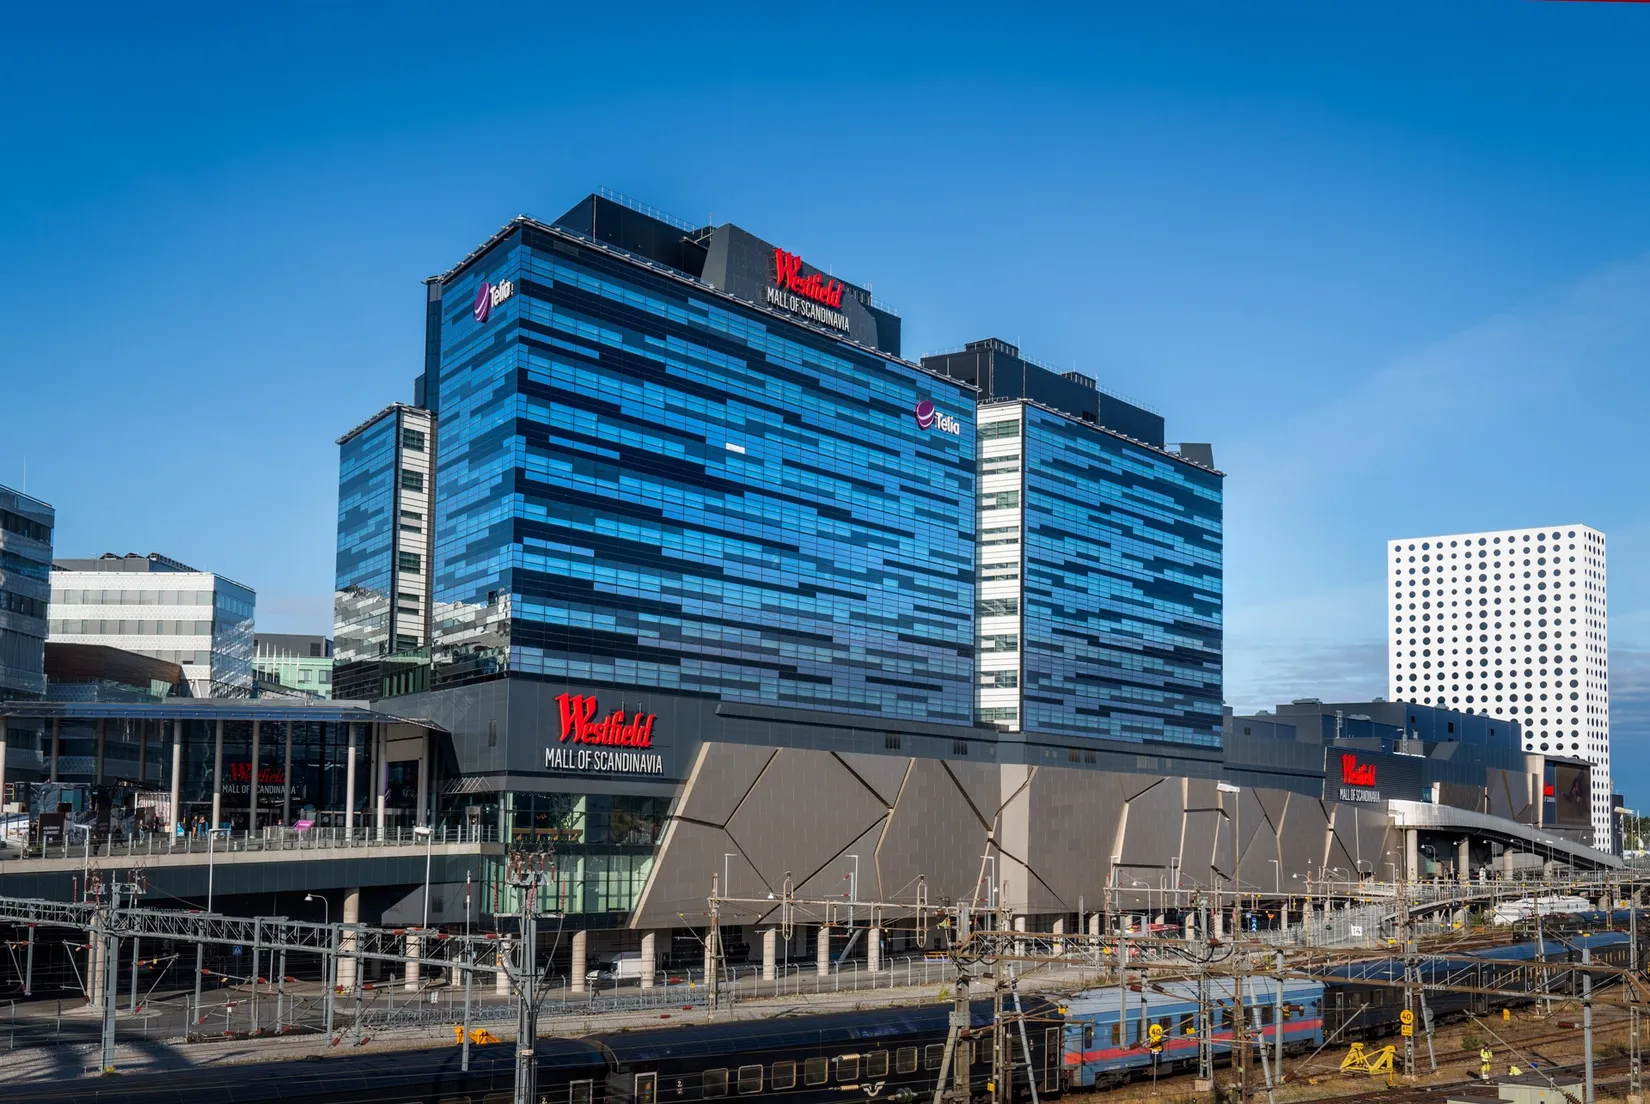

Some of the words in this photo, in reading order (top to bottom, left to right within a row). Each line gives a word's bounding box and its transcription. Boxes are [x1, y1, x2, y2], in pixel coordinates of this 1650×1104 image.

[773, 247, 844, 308] Westfield
[490, 279, 513, 307] Telia
[768, 286, 789, 309] MALL
[790, 295, 800, 313] OF
[801, 300, 849, 332] SCANDINAVIA
[935, 412, 959, 435] Telia
[555, 692, 656, 747] Westfield
[545, 748, 575, 768] MALL
[578, 750, 592, 769] OF
[594, 751, 662, 773] SCANDINAVIA
[222, 785, 240, 793] MALL
[241, 785, 250, 793] OF
[1402, 1013, 1411, 1021] 40
[677, 1080, 682, 1088] 2
